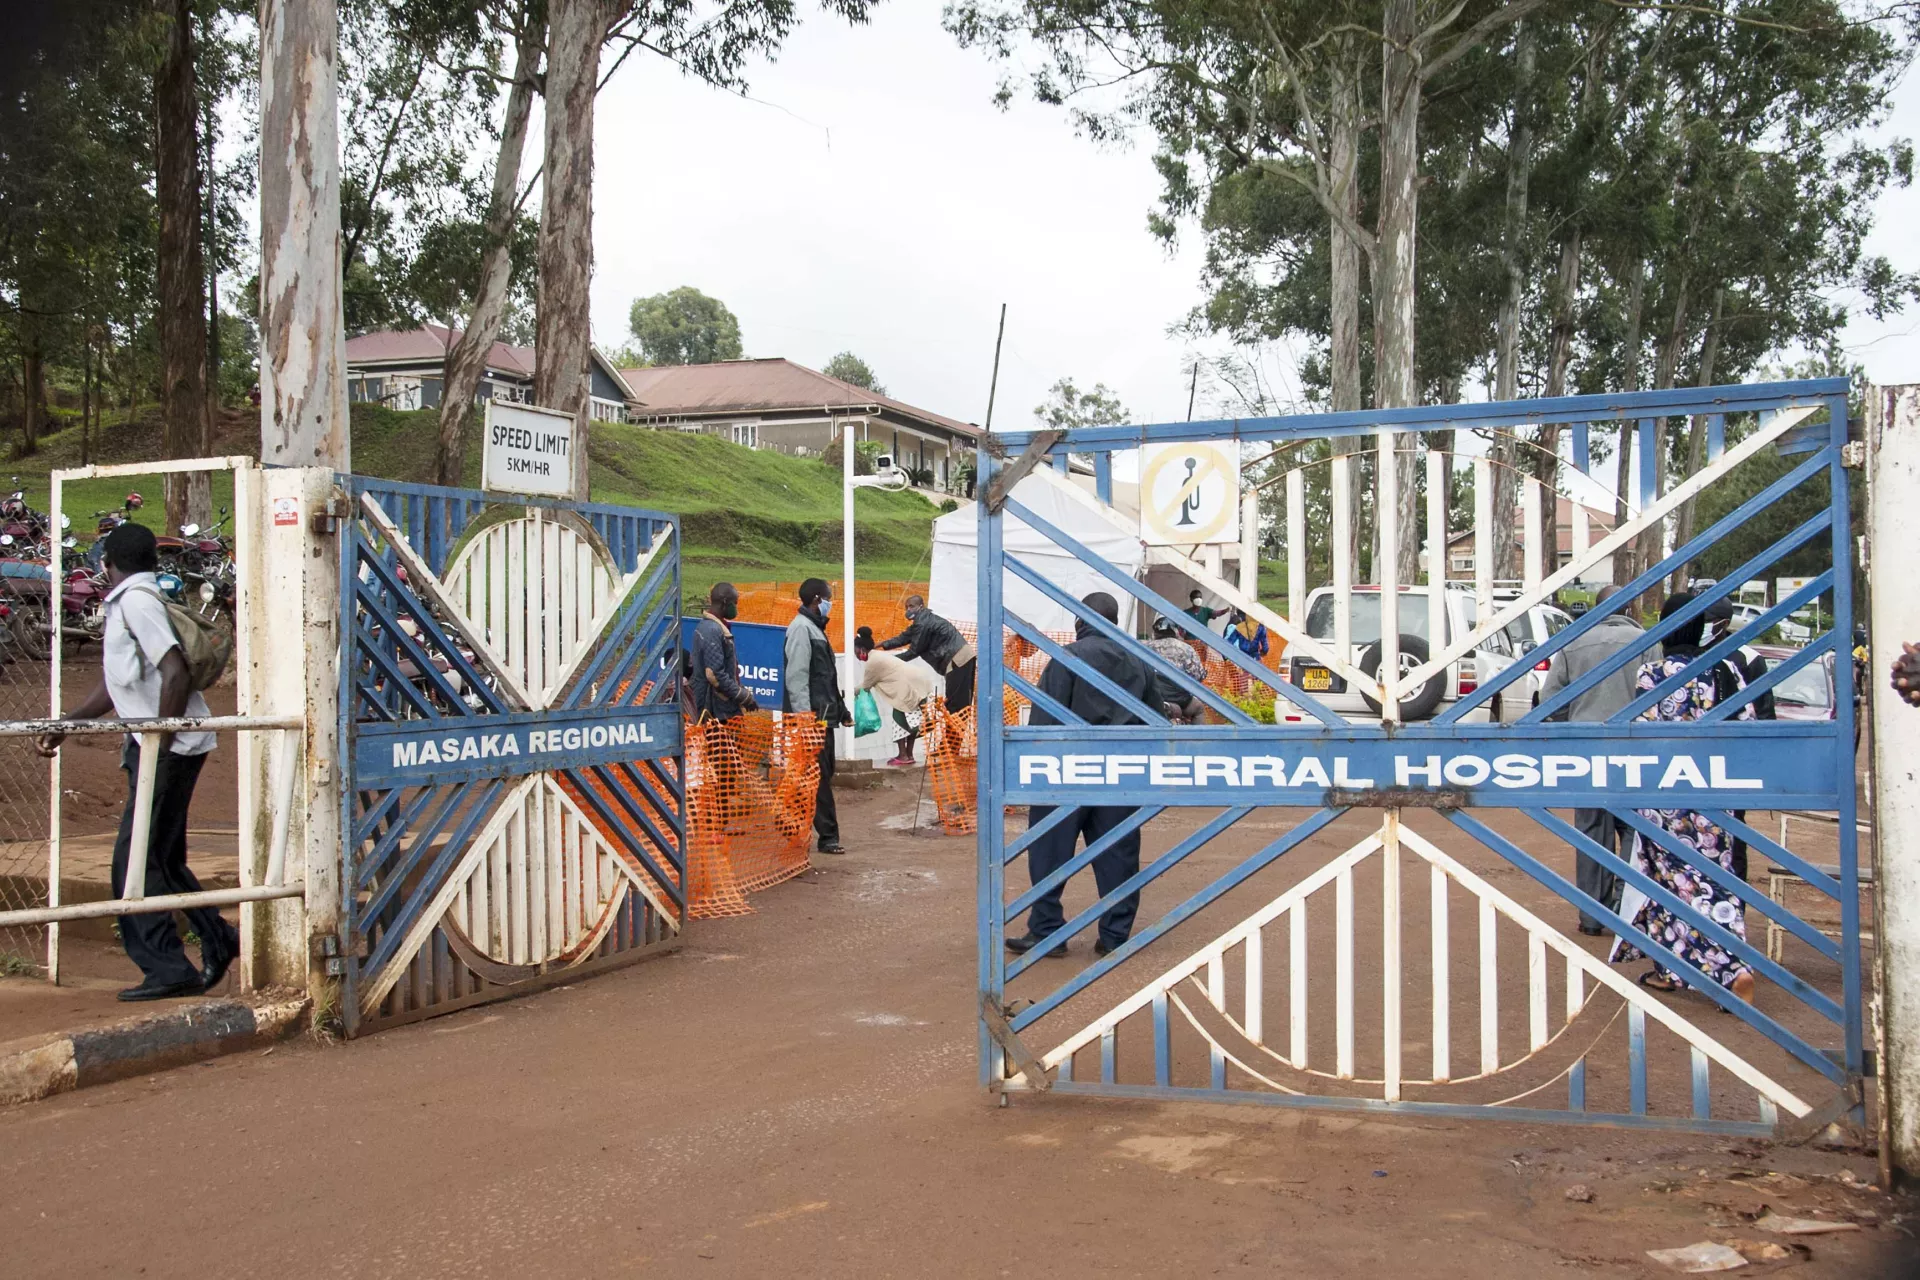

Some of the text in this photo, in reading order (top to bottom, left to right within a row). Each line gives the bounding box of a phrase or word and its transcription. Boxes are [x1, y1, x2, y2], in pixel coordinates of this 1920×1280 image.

[492, 425, 569, 456] SPEED LIMIT
[507, 457, 550, 476] 5KM/HR
[737, 664, 778, 681] OLICE
[1312, 670, 1328, 679] UAJ
[755, 687, 776, 696] POST
[393, 722, 654, 768] MASAKA REGIONAL
[1019, 753, 1764, 789] REFERRAL HOSPITAL
